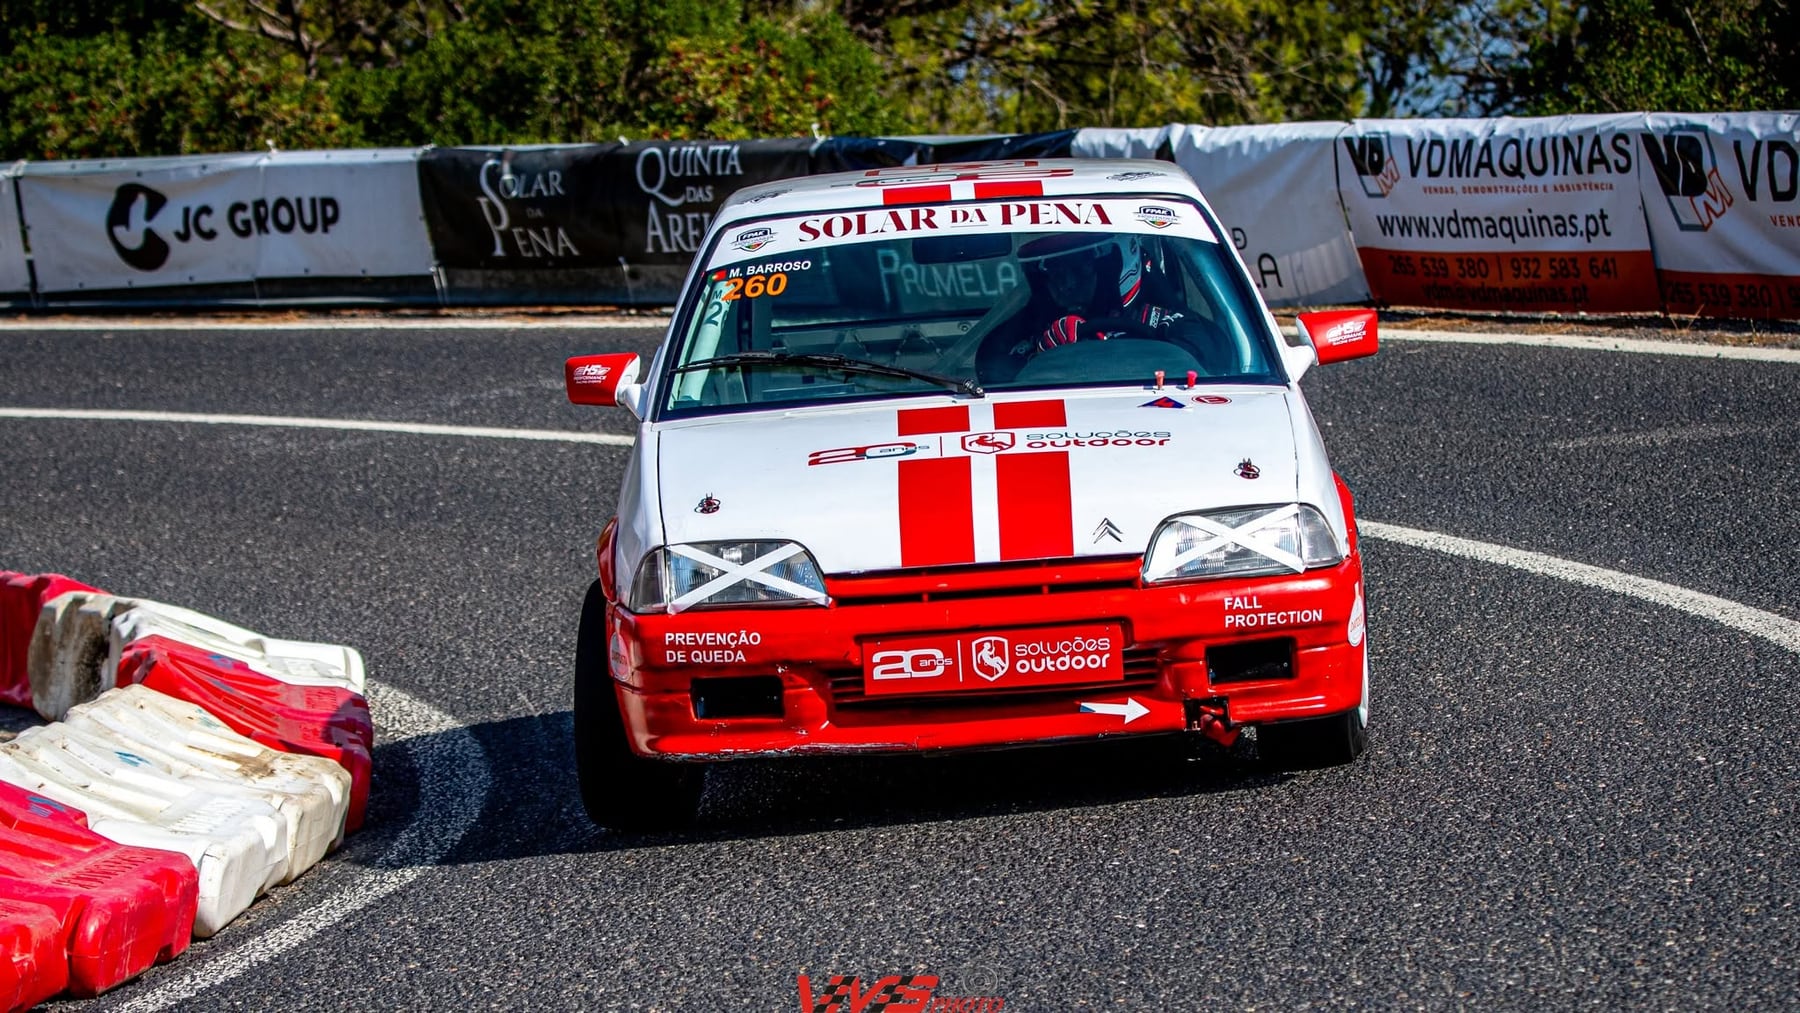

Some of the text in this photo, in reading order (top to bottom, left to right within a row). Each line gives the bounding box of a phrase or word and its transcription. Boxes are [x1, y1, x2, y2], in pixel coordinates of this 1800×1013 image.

[1407, 128, 1633, 180] VDMÁQUINAS
[636, 143, 743, 207] QUINTA
[686, 185, 713, 202] DAS
[1543, 183, 1549, 193] E
[174, 196, 339, 242] JC GROUP
[526, 207, 544, 218] DA
[798, 207, 939, 242] SOLAR
[950, 208, 988, 223] DA
[1000, 203, 1113, 225] PENA
[477, 197, 580, 257] PENA
[1376, 208, 1612, 244] www.vdmaquinas.pt
[729, 260, 812, 278] M. BARROSO
[877, 249, 1018, 304] PALMELA
[1388, 254, 1618, 280] 265 539 380 932 583 641
[721, 272, 788, 301] 260
[1026, 430, 1171, 440] soluções
[1026, 438, 1171, 449] outdoor
[1224, 596, 1263, 610] FALL
[1225, 609, 1323, 628] PROTECTION
[665, 630, 761, 648] PREVENÇÃO
[1015, 636, 1110, 657] soluções
[666, 650, 746, 664] DE QUEDA
[872, 648, 953, 680] 20 anos
[1015, 653, 1110, 674] outdoor
